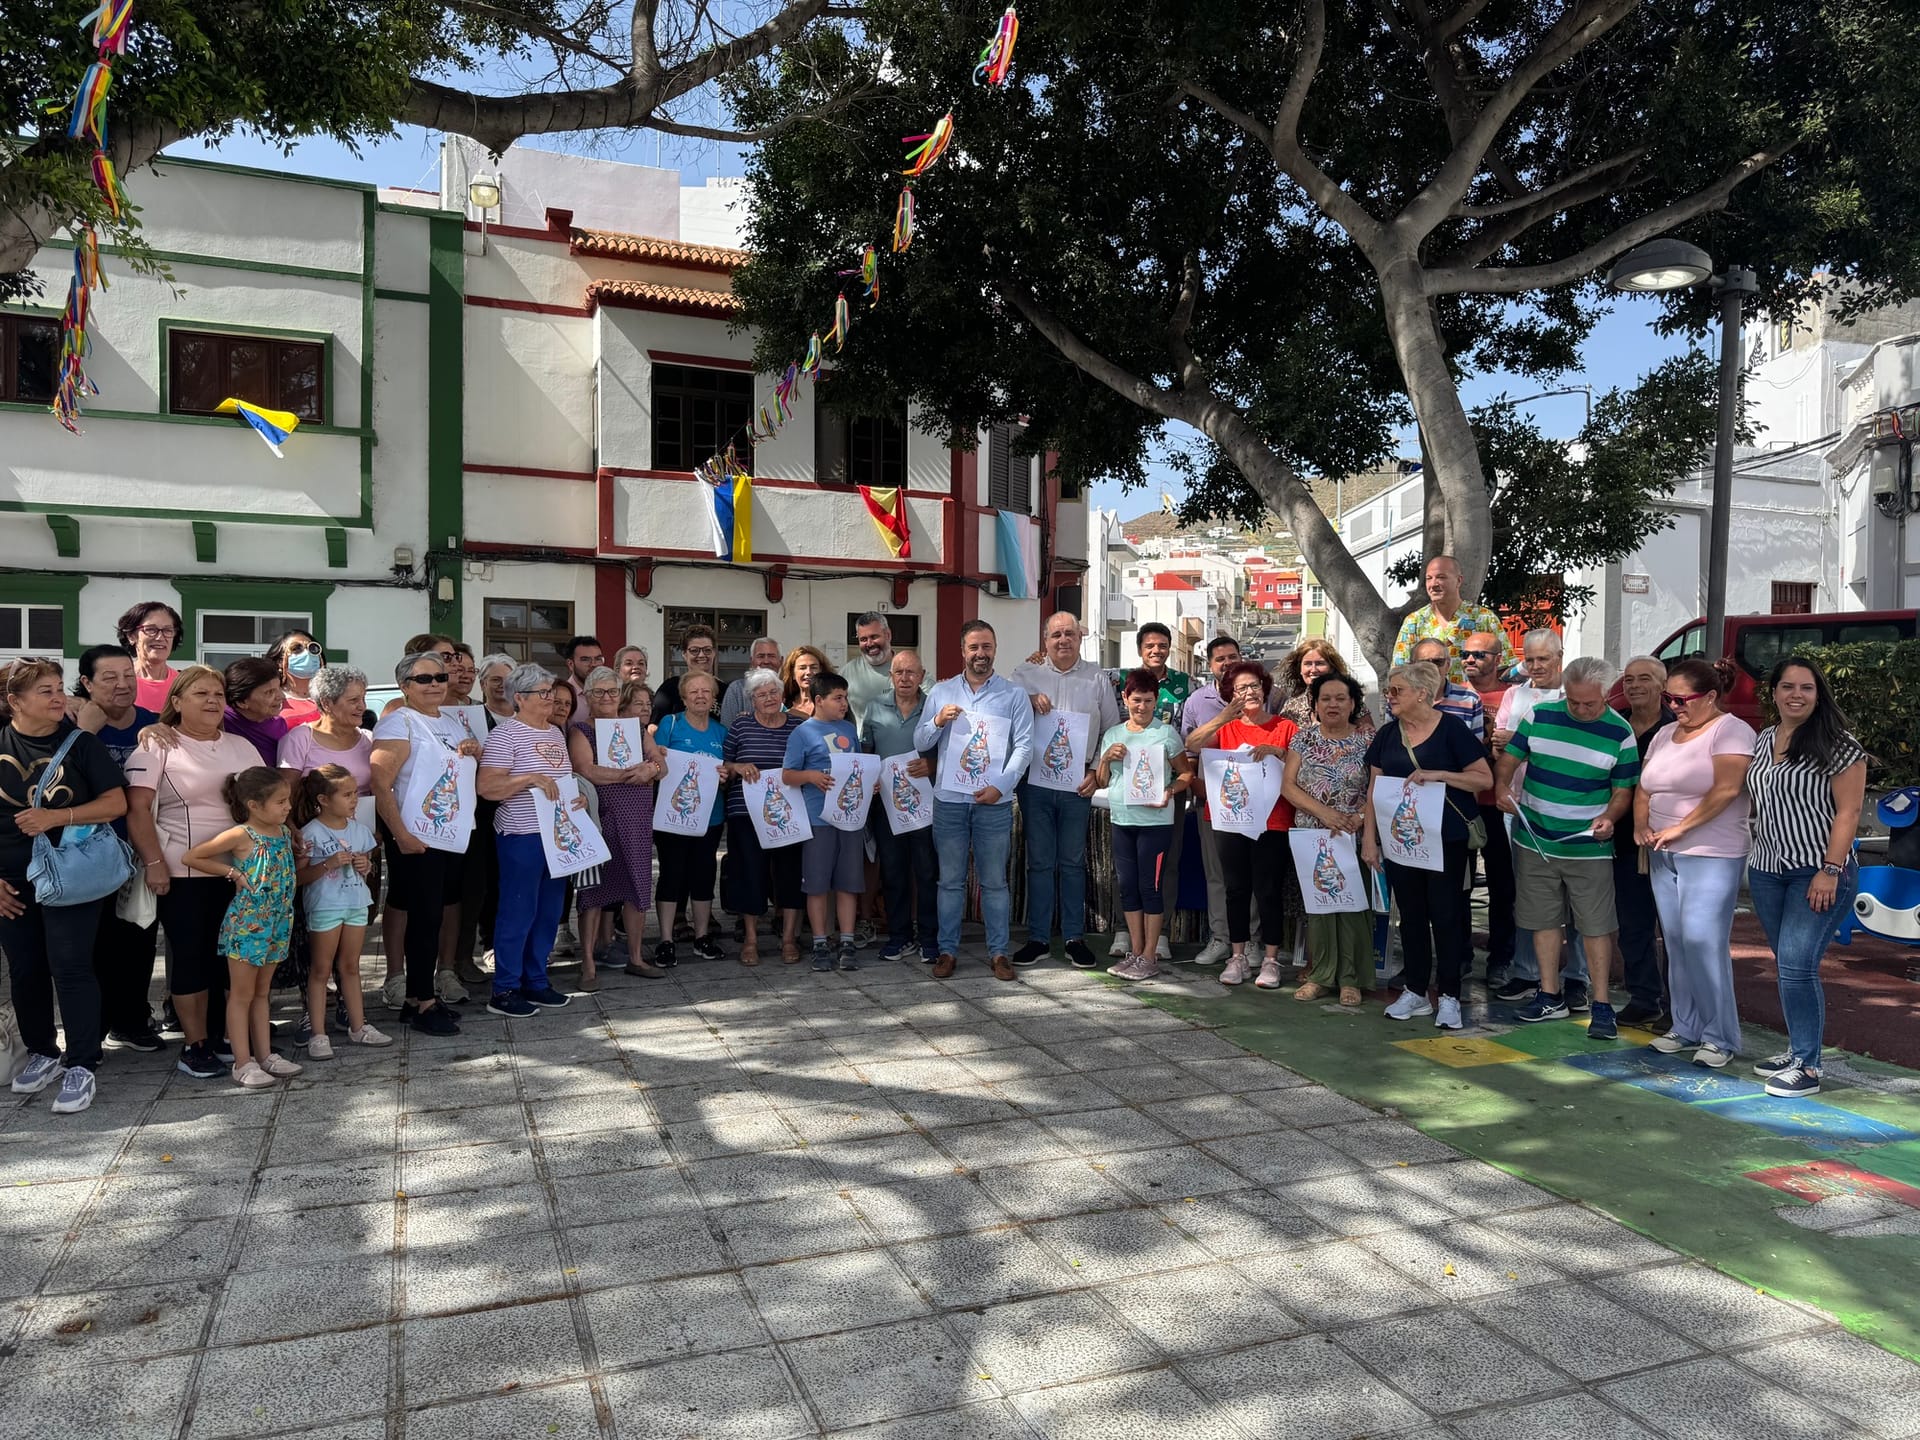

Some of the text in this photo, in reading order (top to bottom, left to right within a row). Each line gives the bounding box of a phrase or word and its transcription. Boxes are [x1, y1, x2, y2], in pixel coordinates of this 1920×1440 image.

[1220, 811, 1254, 821] NIEVES
[412, 819, 457, 840] NIEVES
[1390, 843, 1429, 859] NIEVES
[1313, 894, 1354, 904] NIEVES
